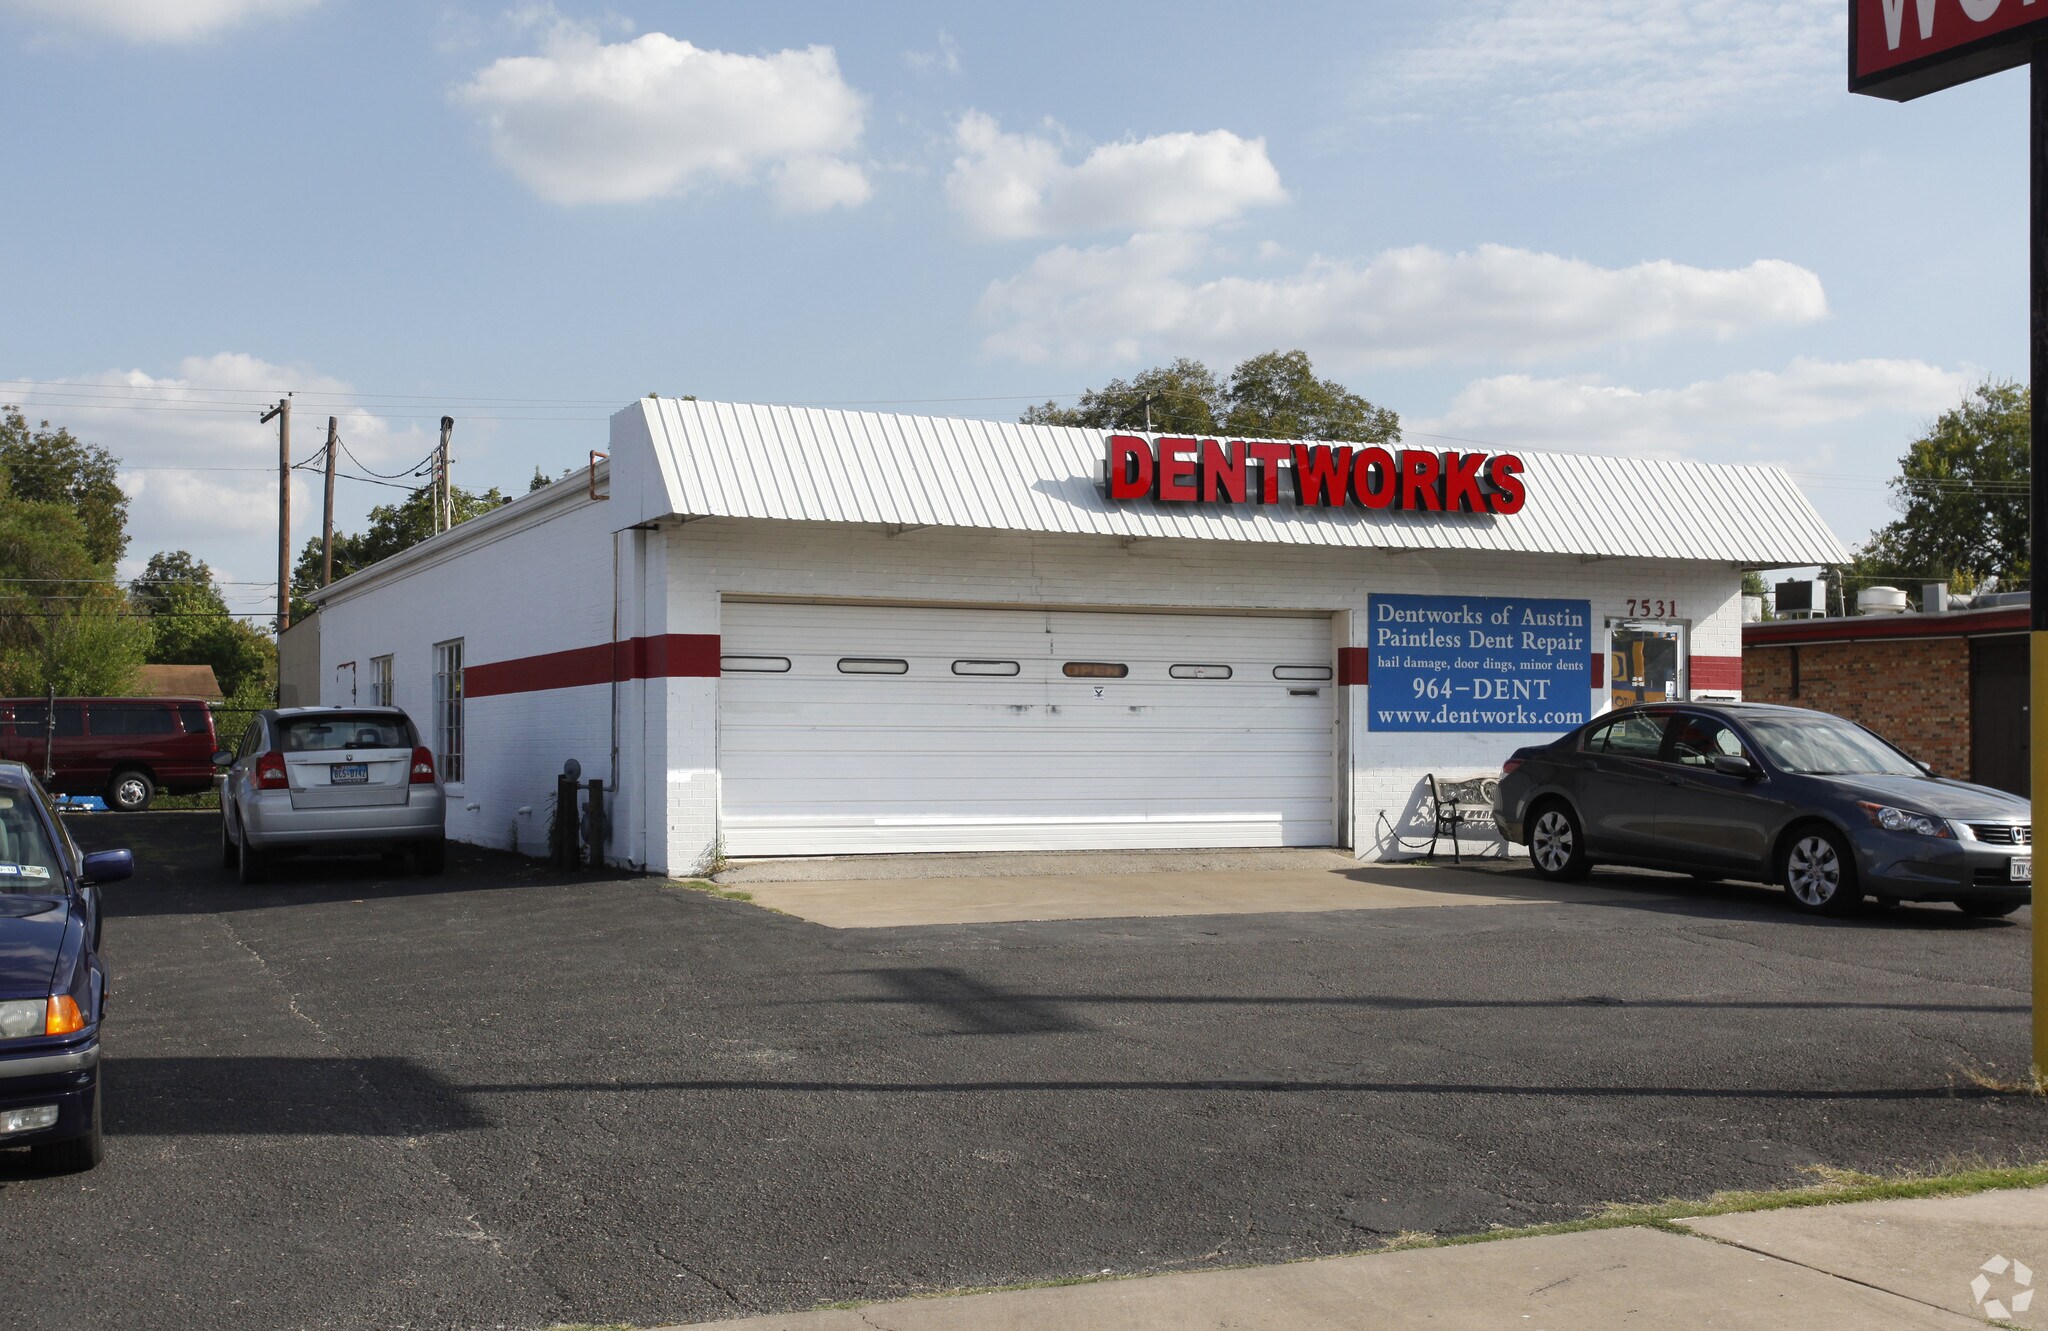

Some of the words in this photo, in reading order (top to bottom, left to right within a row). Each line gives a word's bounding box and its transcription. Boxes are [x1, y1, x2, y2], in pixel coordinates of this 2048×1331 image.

[1107, 434, 1526, 515] DENTWORKS
[1377, 603, 1484, 625] Dentworks
[1490, 605, 1513, 625] of
[1521, 607, 1584, 627] Austin
[1626, 599, 1678, 618] 7531
[1377, 627, 1462, 648] Paintless
[1468, 630, 1514, 649] Dent
[1521, 631, 1583, 655] Repair
[1065, 664, 1121, 677] OPEN
[1377, 655, 1400, 668] hail
[1403, 656, 1451, 672] damage,
[1454, 657, 1479, 669] door
[1483, 657, 1516, 673] dings,
[1520, 659, 1552, 670] minor
[1556, 658, 1584, 671] dents
[1412, 677, 1551, 700] 964-DENT
[1377, 704, 1584, 725] www.dentworks.com
